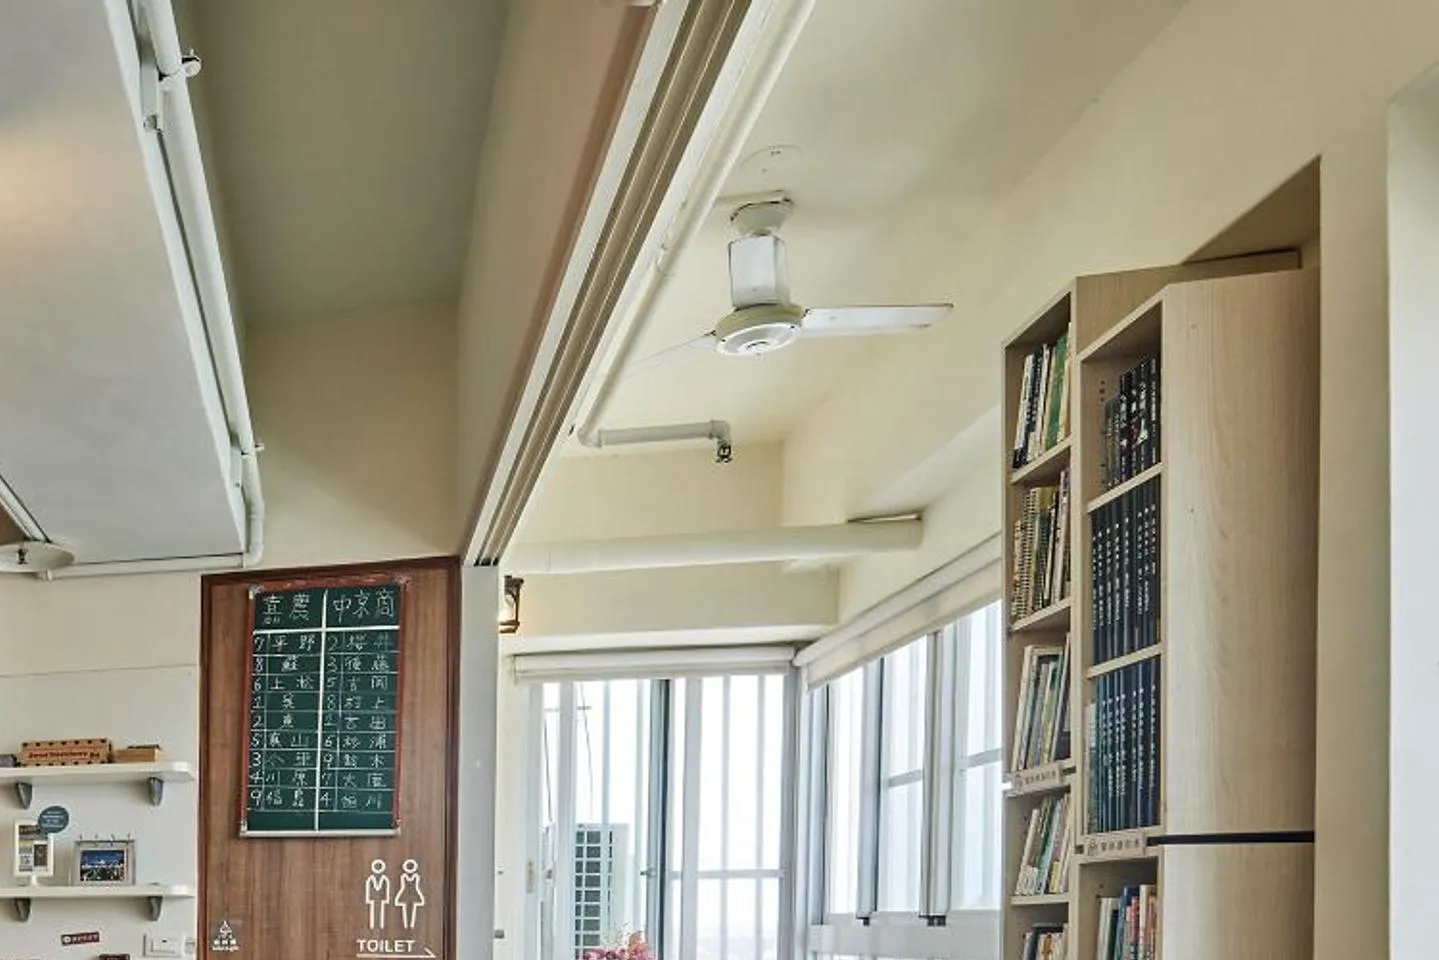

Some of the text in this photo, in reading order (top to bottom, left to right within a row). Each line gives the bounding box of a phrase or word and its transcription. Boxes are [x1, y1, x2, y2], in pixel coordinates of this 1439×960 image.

[332, 588, 395, 623] 中京商
[254, 657, 264, 673] 8
[252, 751, 262, 767] 3
[357, 938, 416, 953] TOILET
